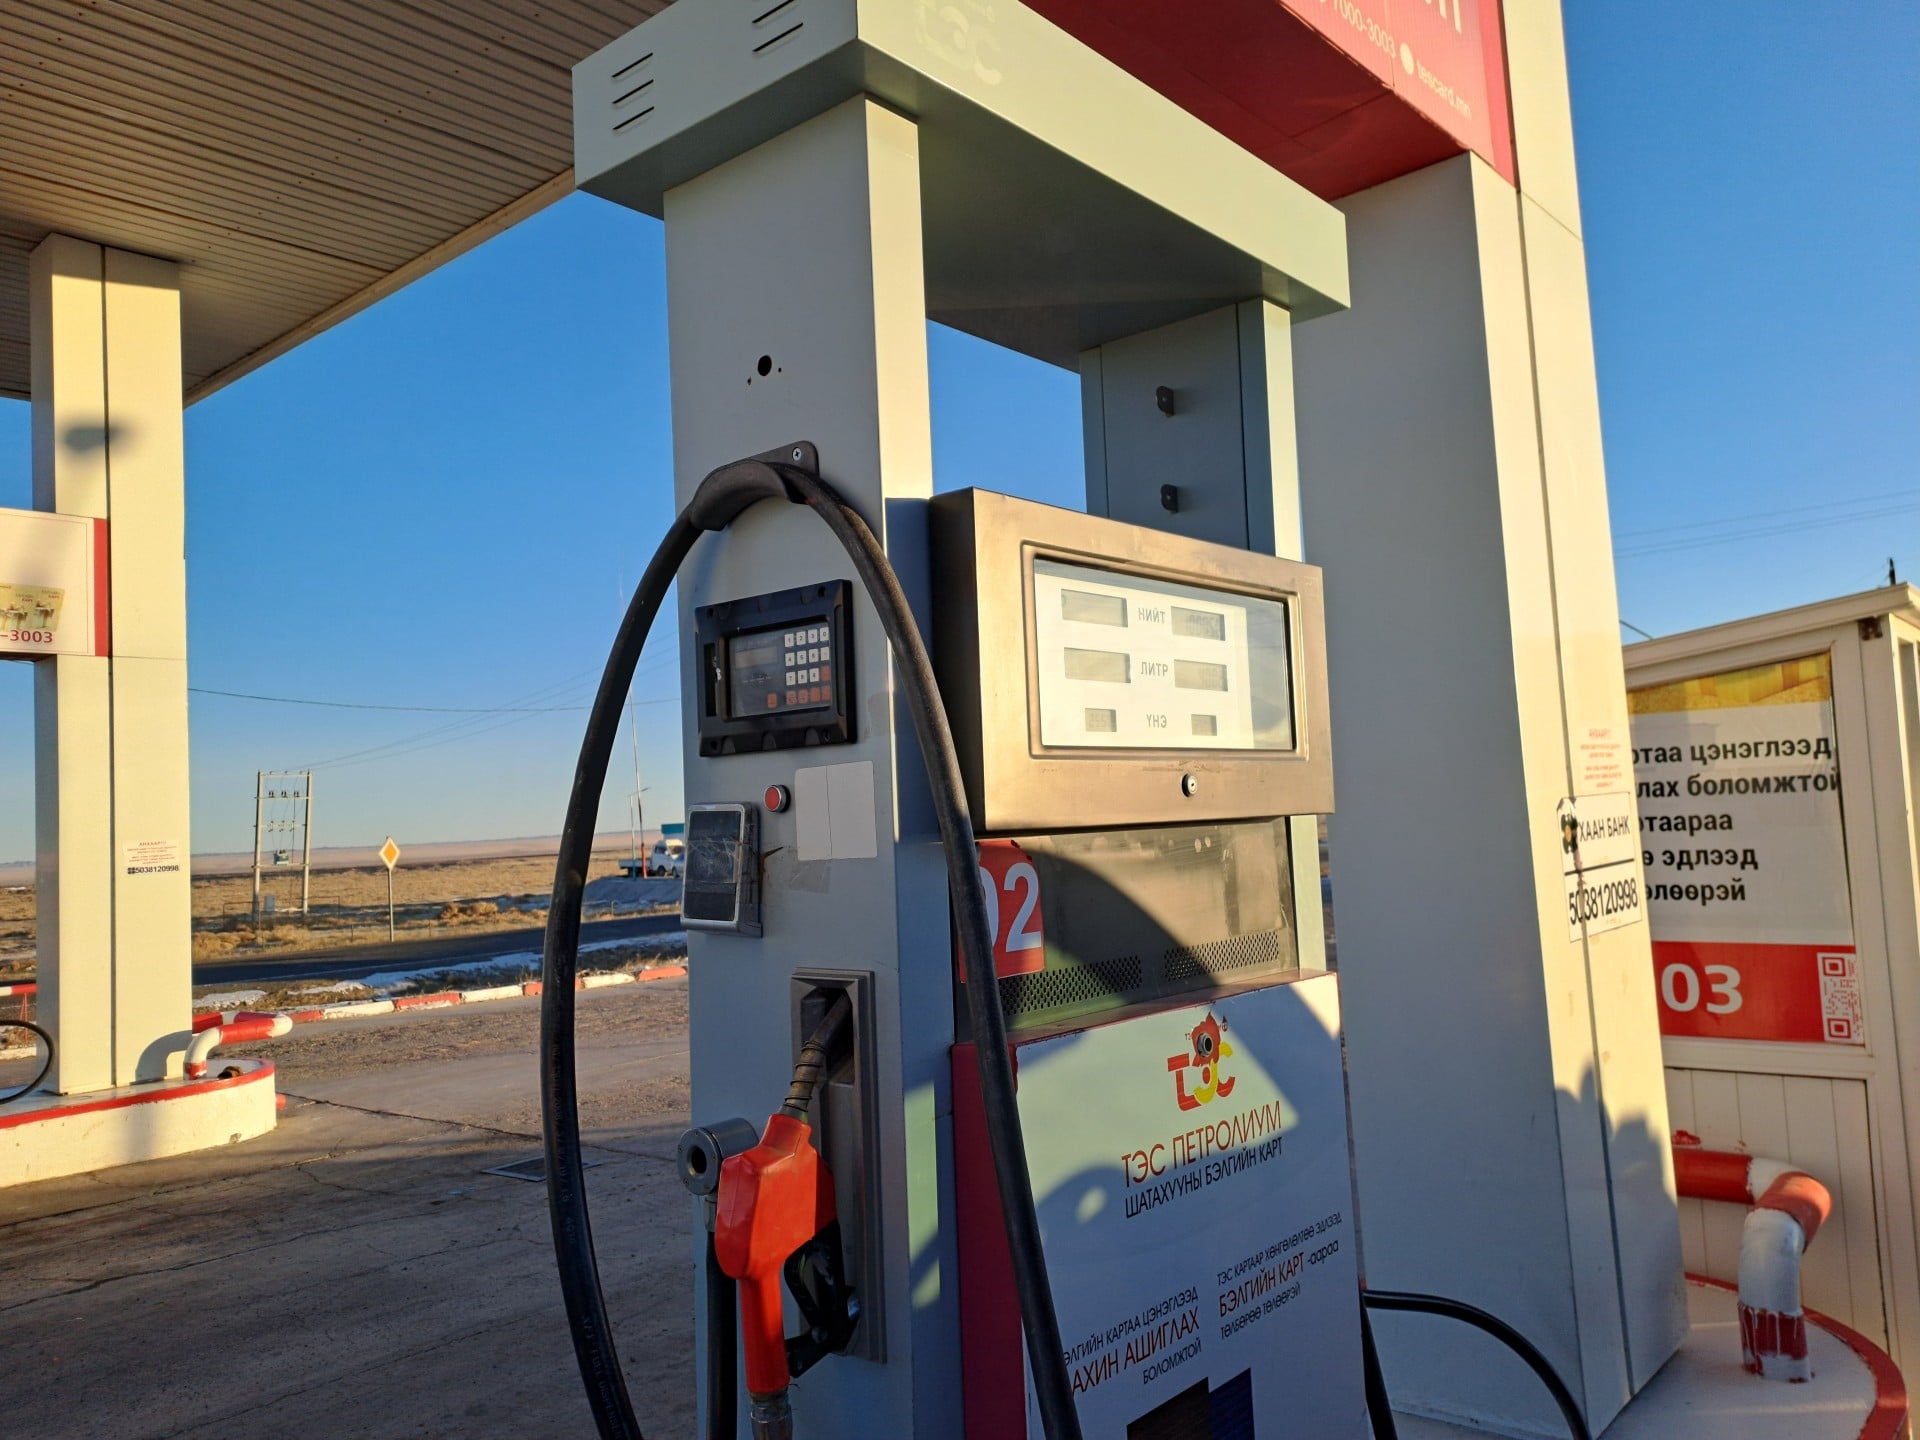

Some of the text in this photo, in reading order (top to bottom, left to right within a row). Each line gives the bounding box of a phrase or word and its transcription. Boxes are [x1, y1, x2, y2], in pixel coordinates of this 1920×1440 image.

[1416, 59, 1472, 120] tescard.mn
[1138, 607, 1166, 624] НИЙТ
[1140, 661, 1169, 677] ЛИТР
[1690, 737, 1832, 766] цэнэглээд
[1636, 767, 1840, 798] лах боломжтой
[1579, 816, 1631, 842] ХААН БАНК
[1662, 848, 1759, 870] эдлээд
[1568, 877, 1639, 926] 5038120998
[1121, 1100, 1282, 1188] ТЭС ПЕТРОЛИУМ
[1125, 1136, 1283, 1219] ШАТАХУУНЫ БЭЛГИЙН КАРТ
[1217, 1268, 1233, 1287] ТЭС
[1234, 1251, 1265, 1278] КАРТААР
[1219, 1267, 1277, 1318] БЭЛГИЙН
[1278, 1251, 1305, 1285] КАРТ
[1064, 1286, 1199, 1367] ЭЛГИЙН КАРТАА ЦЭНЭГЛЭЭД
[1072, 1305, 1200, 1395] АХИН АШИГЛАХ
[1142, 1335, 1202, 1385] БОЛОМЖТОЙ
